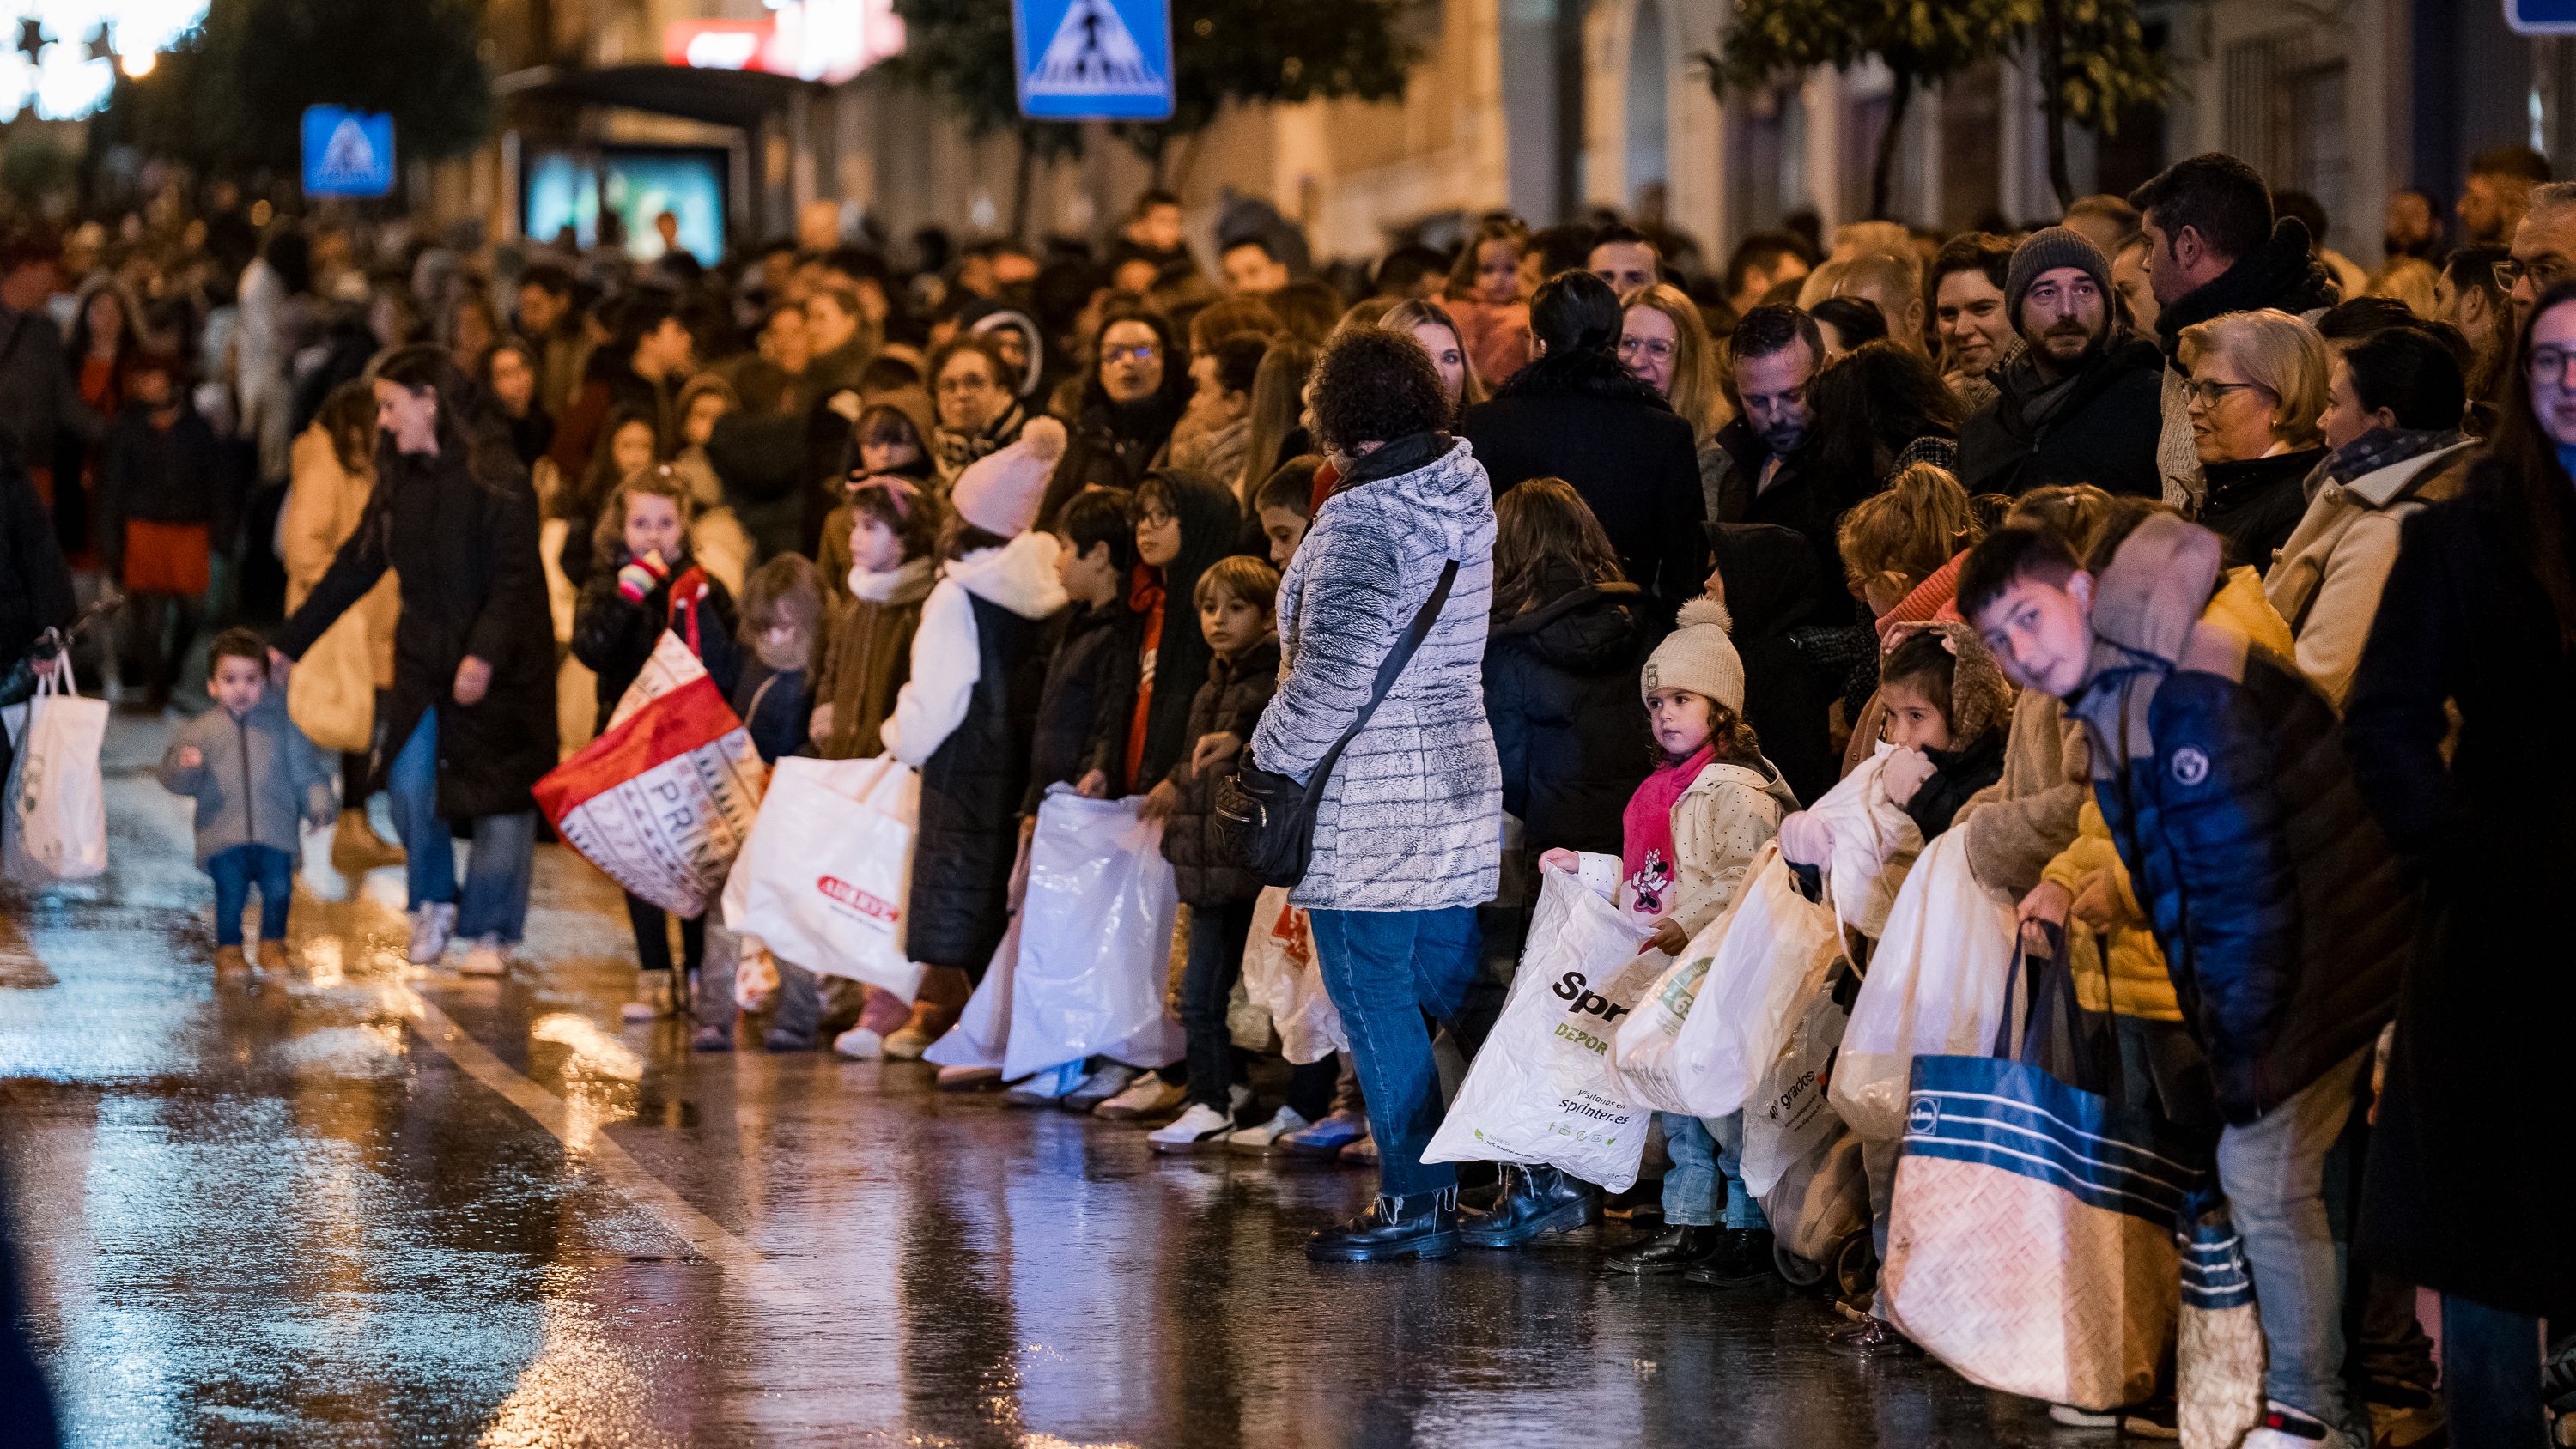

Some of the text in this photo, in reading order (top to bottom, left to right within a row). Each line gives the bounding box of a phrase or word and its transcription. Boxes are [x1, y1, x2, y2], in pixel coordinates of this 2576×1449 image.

[1646, 663, 1659, 691] B
[1552, 971, 1631, 1022] Spr
[1554, 1022, 1609, 1056] DEPOR
[1780, 1070, 1815, 1110] grados
[1558, 1099, 1630, 1125] sprinter.es
